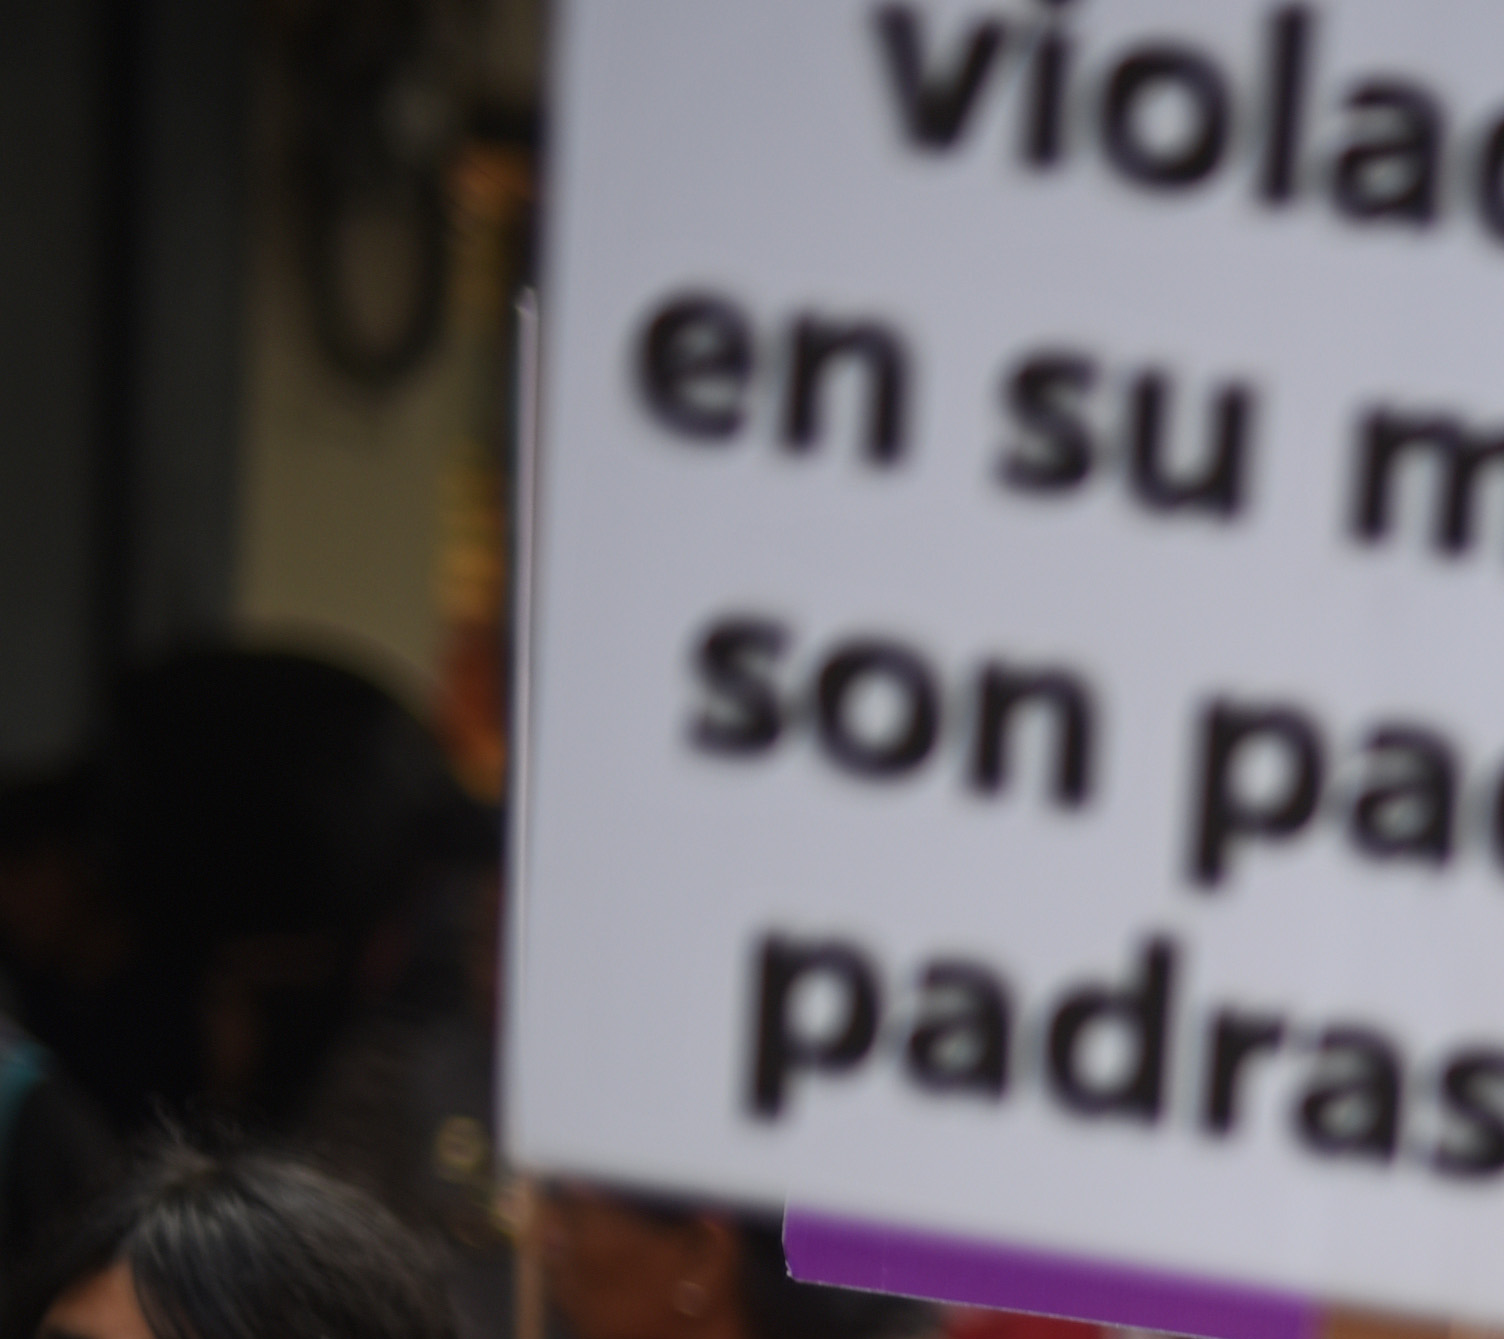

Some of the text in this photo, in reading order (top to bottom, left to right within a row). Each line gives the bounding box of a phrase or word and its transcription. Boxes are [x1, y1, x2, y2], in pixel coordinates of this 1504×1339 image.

[627, 282, 914, 470] en
[994, 340, 1260, 527] su
[686, 603, 1102, 810] son
